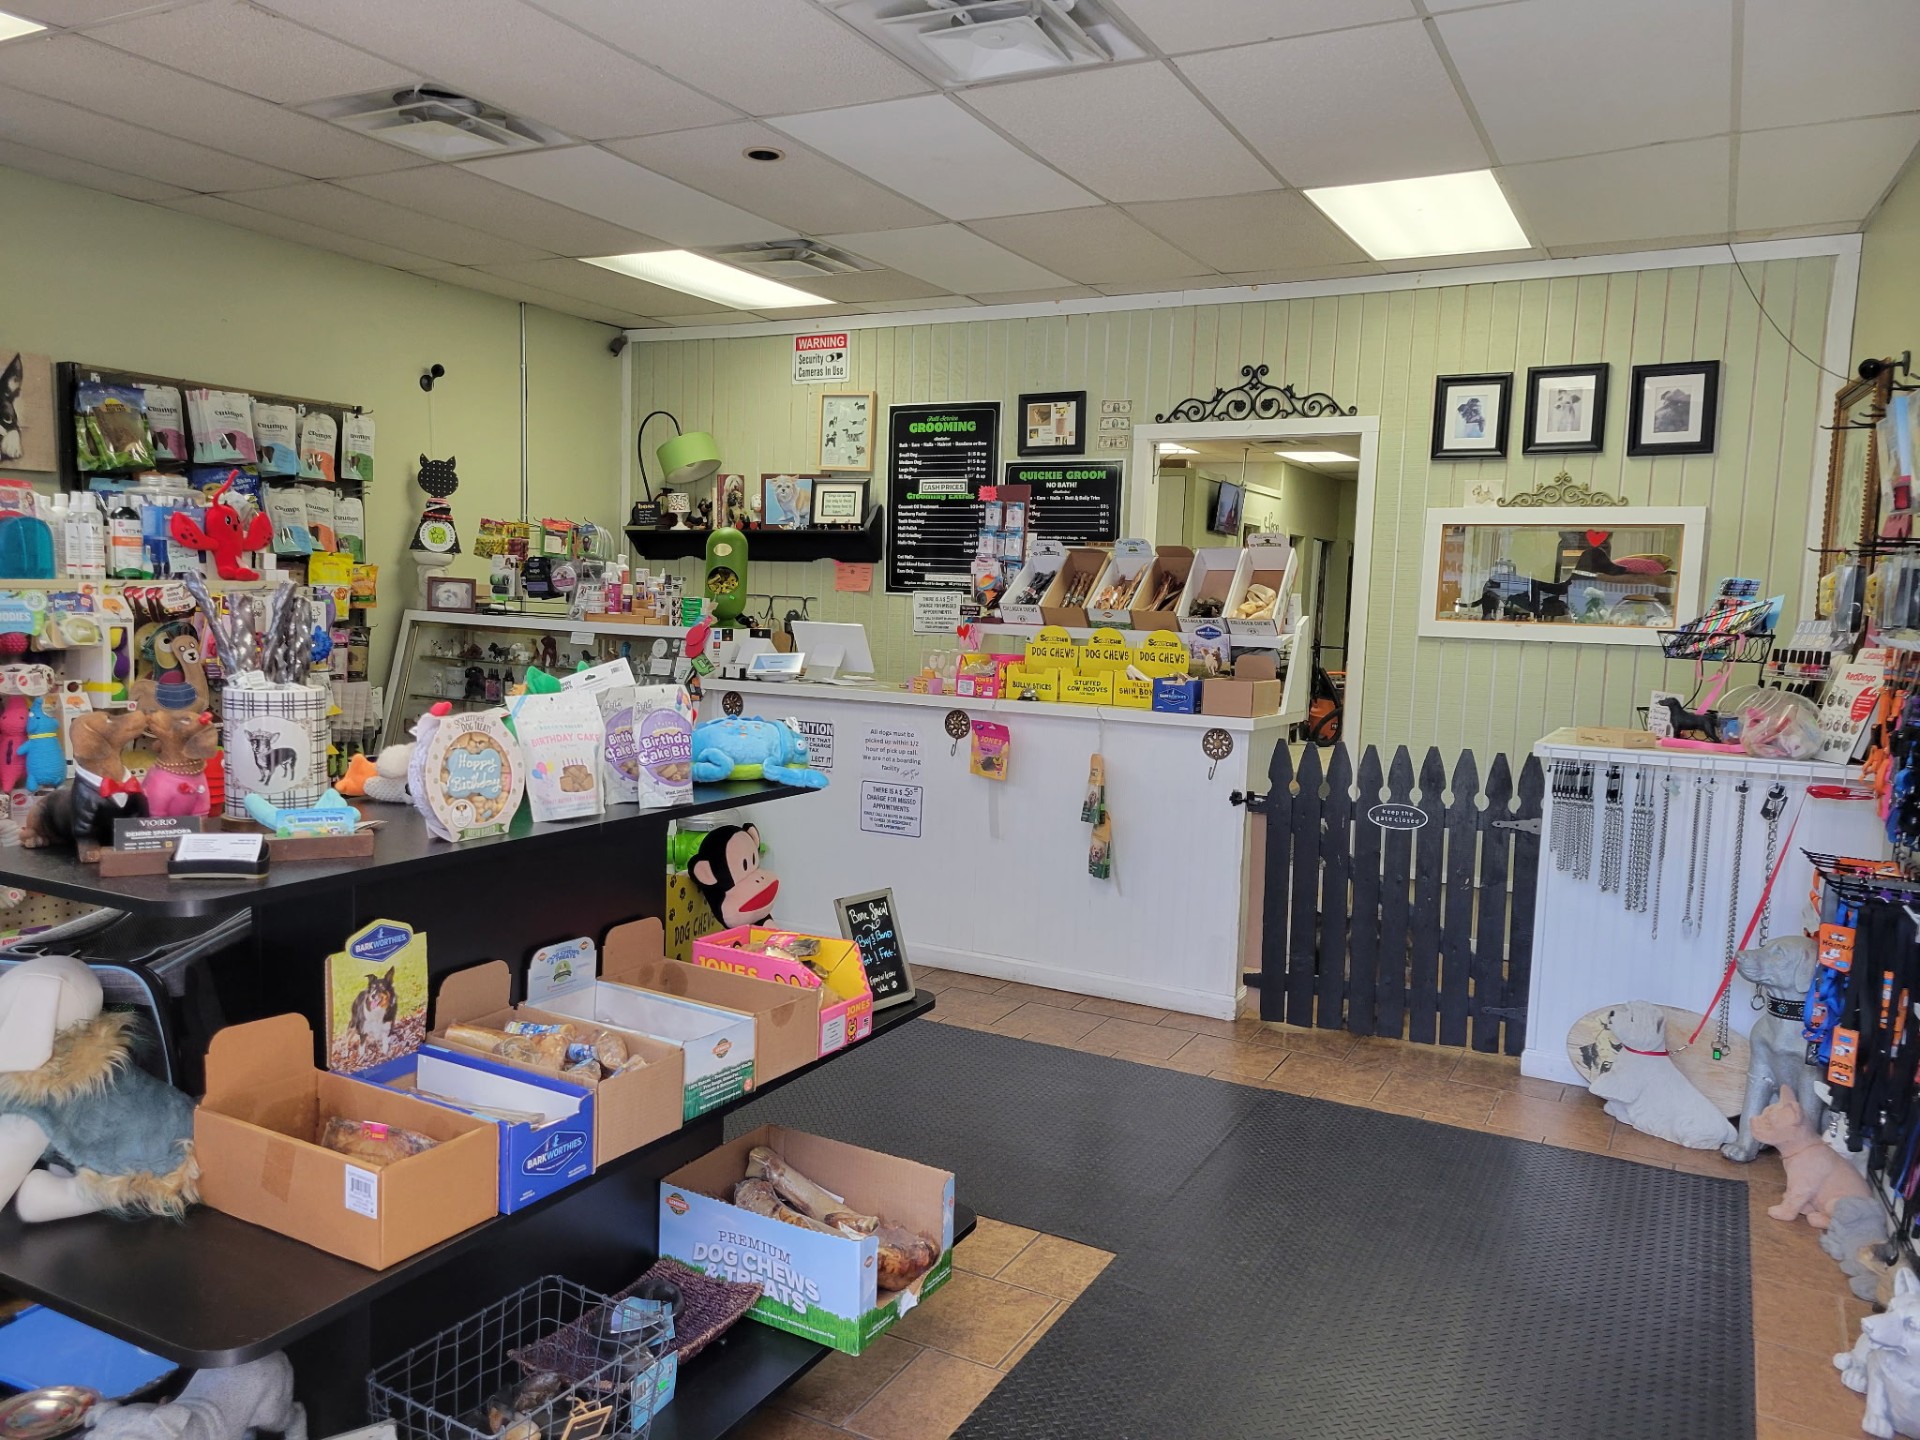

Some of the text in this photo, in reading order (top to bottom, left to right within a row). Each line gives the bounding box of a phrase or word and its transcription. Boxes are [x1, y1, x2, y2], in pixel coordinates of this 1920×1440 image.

[798, 335, 845, 350] WARNING
[798, 353, 824, 365] Security
[798, 365, 844, 378] Cameras In Use
[909, 421, 977, 433] GROOMING
[1019, 470, 1107, 481] QUICKIE GROOM
[941, 483, 964, 491] PRICES
[1796, 621, 1832, 634] COLOR
[1031, 646, 1075, 659] DOG CHEWS
[1085, 648, 1130, 661] DOG CHEWS
[1139, 652, 1185, 664] DOG CHEWS
[1845, 671, 1877, 684] RedDingo
[1012, 680, 1052, 691] BULLY STICKS
[1082, 685, 1108, 693] HOOVES
[1119, 687, 1137, 696] SHIN
[460, 722, 474, 733] DOG
[798, 721, 834, 736] ENTION
[878, 729, 892, 737] dogs
[893, 730, 905, 738] must
[531, 732, 600, 748] BIRTHDAY CAKE
[608, 731, 633, 746] Birth
[865, 737, 884, 745] picked
[980, 735, 1003, 745] JONES
[638, 744, 692, 767] Cake Bit
[886, 747, 898, 755] pick
[457, 753, 498, 772] Happy
[896, 757, 922, 766] boarding
[446, 770, 502, 793] Birthday
[872, 786, 888, 794] THERE
[866, 793, 917, 806] CHARGE FOR MISSED
[872, 802, 910, 814] APPOINTMENTS
[1382, 808, 1400, 816] keep
[1394, 816, 1420, 825] closed
[849, 908, 870, 925] Bone
[674, 920, 691, 948] DOG
[355, 933, 408, 953] BARKWORTHIES
[855, 934, 873, 951] Buy
[698, 955, 758, 978] JONES
[846, 998, 870, 1017] JONES
[526, 1136, 583, 1170] BARKWORTHIES
[717, 1229, 791, 1266] PREMIUM
[692, 1241, 822, 1303] DOG CHEWS
[703, 1261, 720, 1278] &
